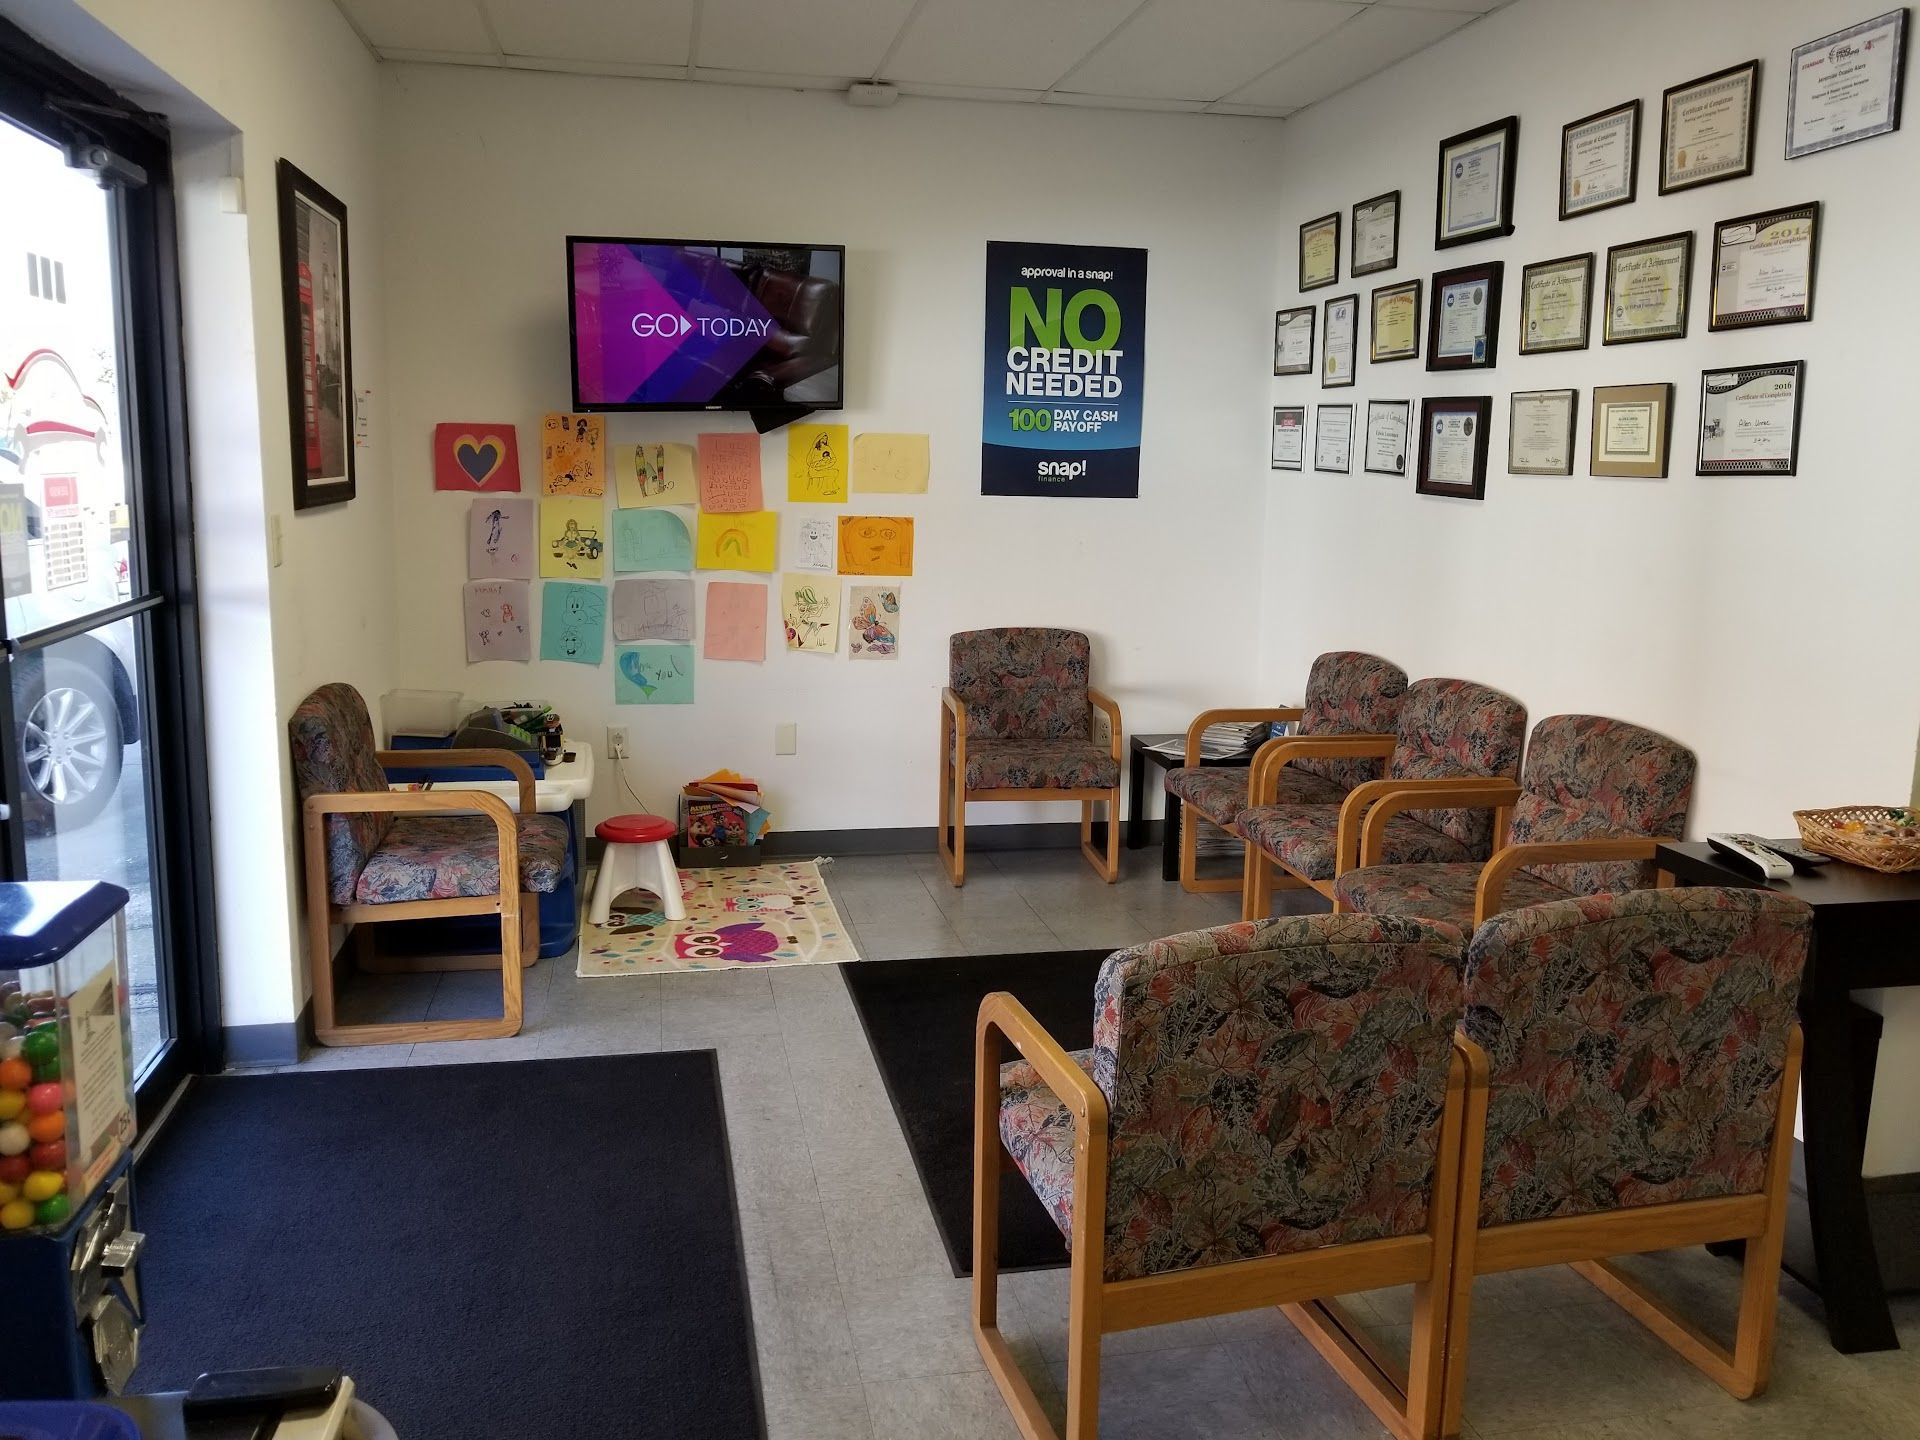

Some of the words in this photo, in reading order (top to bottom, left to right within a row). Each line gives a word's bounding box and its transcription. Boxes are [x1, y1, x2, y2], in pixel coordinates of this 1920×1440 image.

[1021, 267, 1066, 278] approval
[1068, 268, 1076, 278] in
[1078, 270, 1084, 279] a
[1085, 270, 1114, 282] snap!
[631, 312, 679, 337] GO
[696, 318, 772, 337] TODAY
[1009, 286, 1122, 355] NO
[1006, 346, 1124, 375] CREDIT
[1006, 372, 1123, 398] NEEDED
[1774, 382, 1792, 390] 2016
[1735, 392, 1759, 401] Certificate
[1765, 391, 1792, 400] Completion
[1008, 407, 1052, 432] 100
[1053, 409, 1079, 421] DAY
[1082, 410, 1118, 422] CASH
[1053, 421, 1102, 433] PAYOFF
[1037, 460, 1087, 480] snap!
